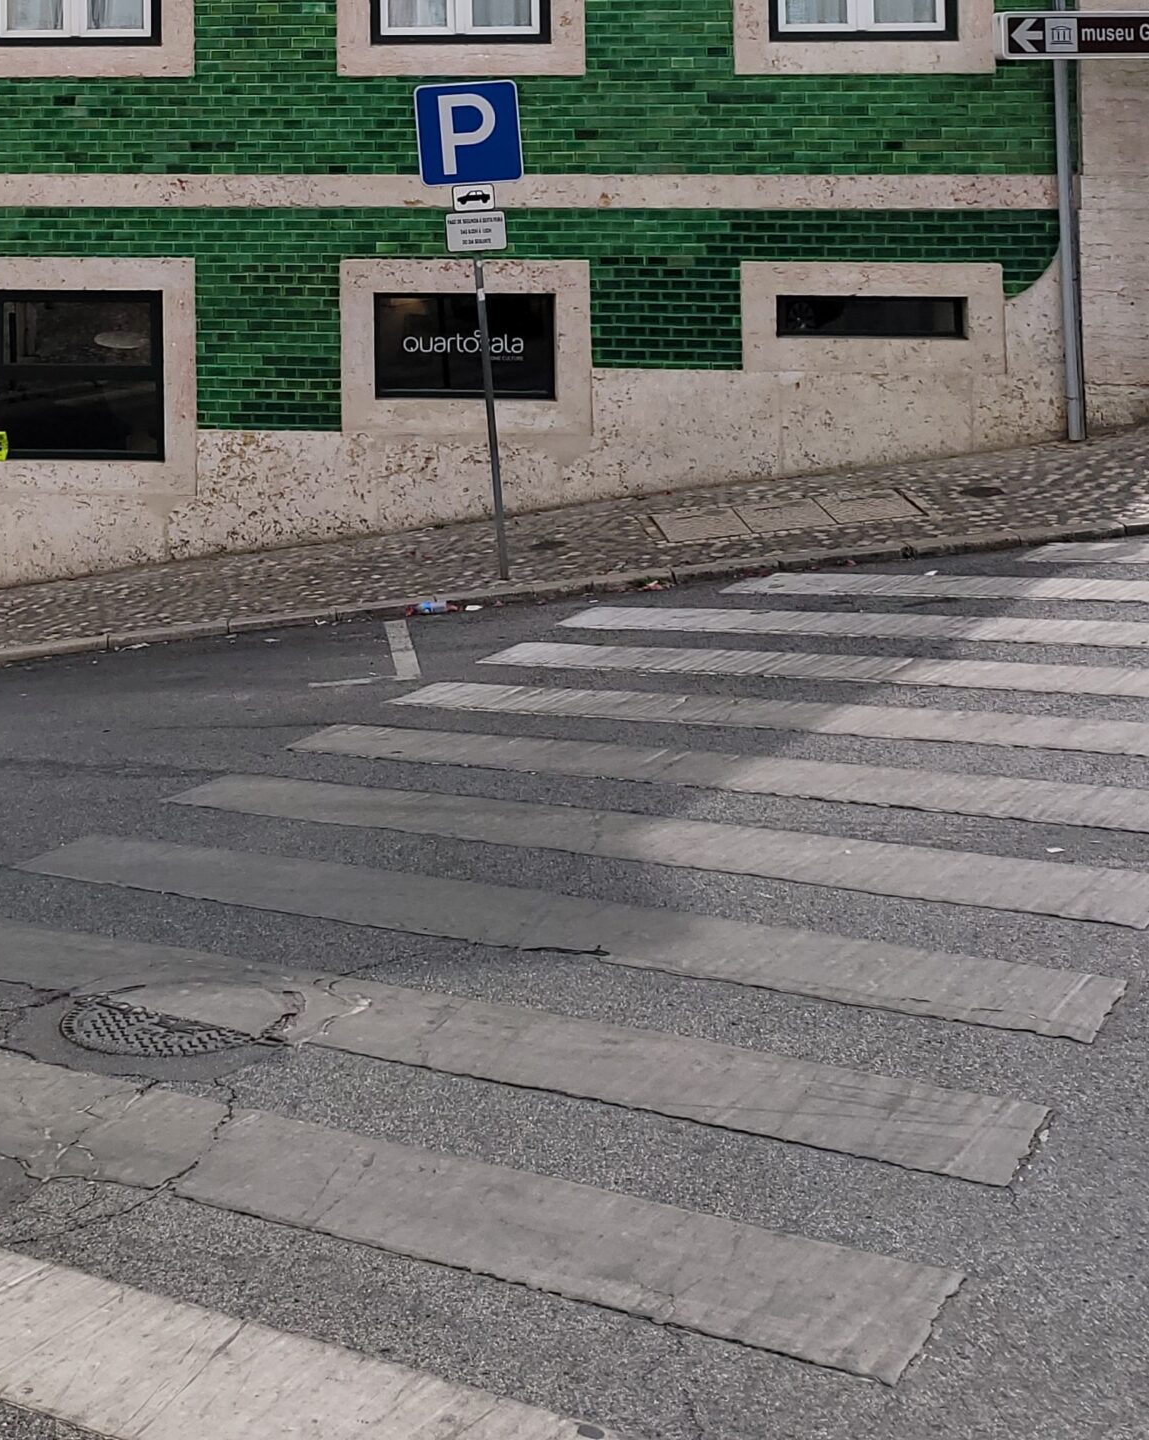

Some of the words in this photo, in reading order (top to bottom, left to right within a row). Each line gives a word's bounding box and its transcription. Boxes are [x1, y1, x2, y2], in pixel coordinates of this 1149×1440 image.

[1081, 27, 1134, 41] museu
[437, 93, 496, 175] P
[403, 329, 524, 354] quartoala
